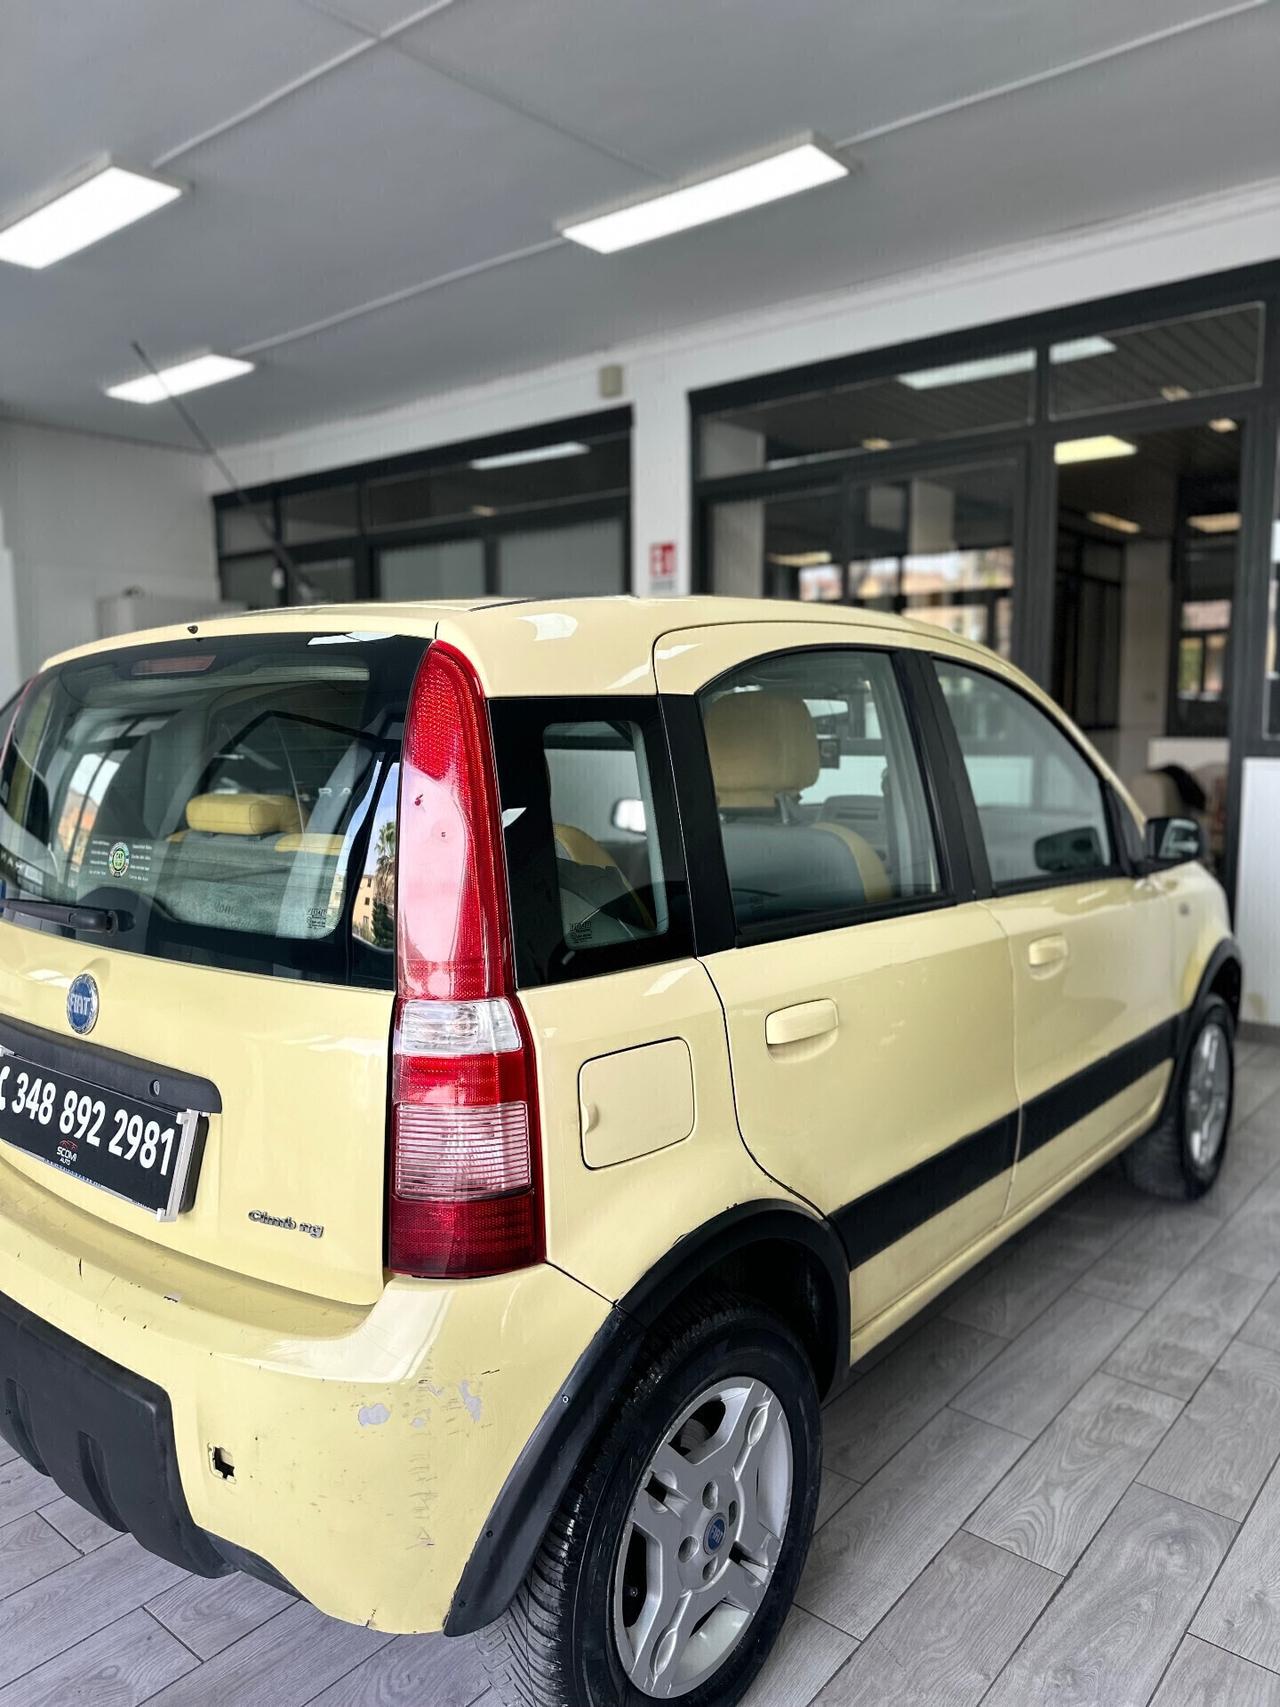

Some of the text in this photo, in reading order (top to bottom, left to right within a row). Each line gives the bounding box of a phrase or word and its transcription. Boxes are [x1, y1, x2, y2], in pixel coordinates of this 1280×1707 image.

[69, 992, 91, 1015] FIAT
[11, 1072, 56, 1126] 348
[59, 1090, 106, 1147] 892
[108, 1109, 175, 1176] 2981
